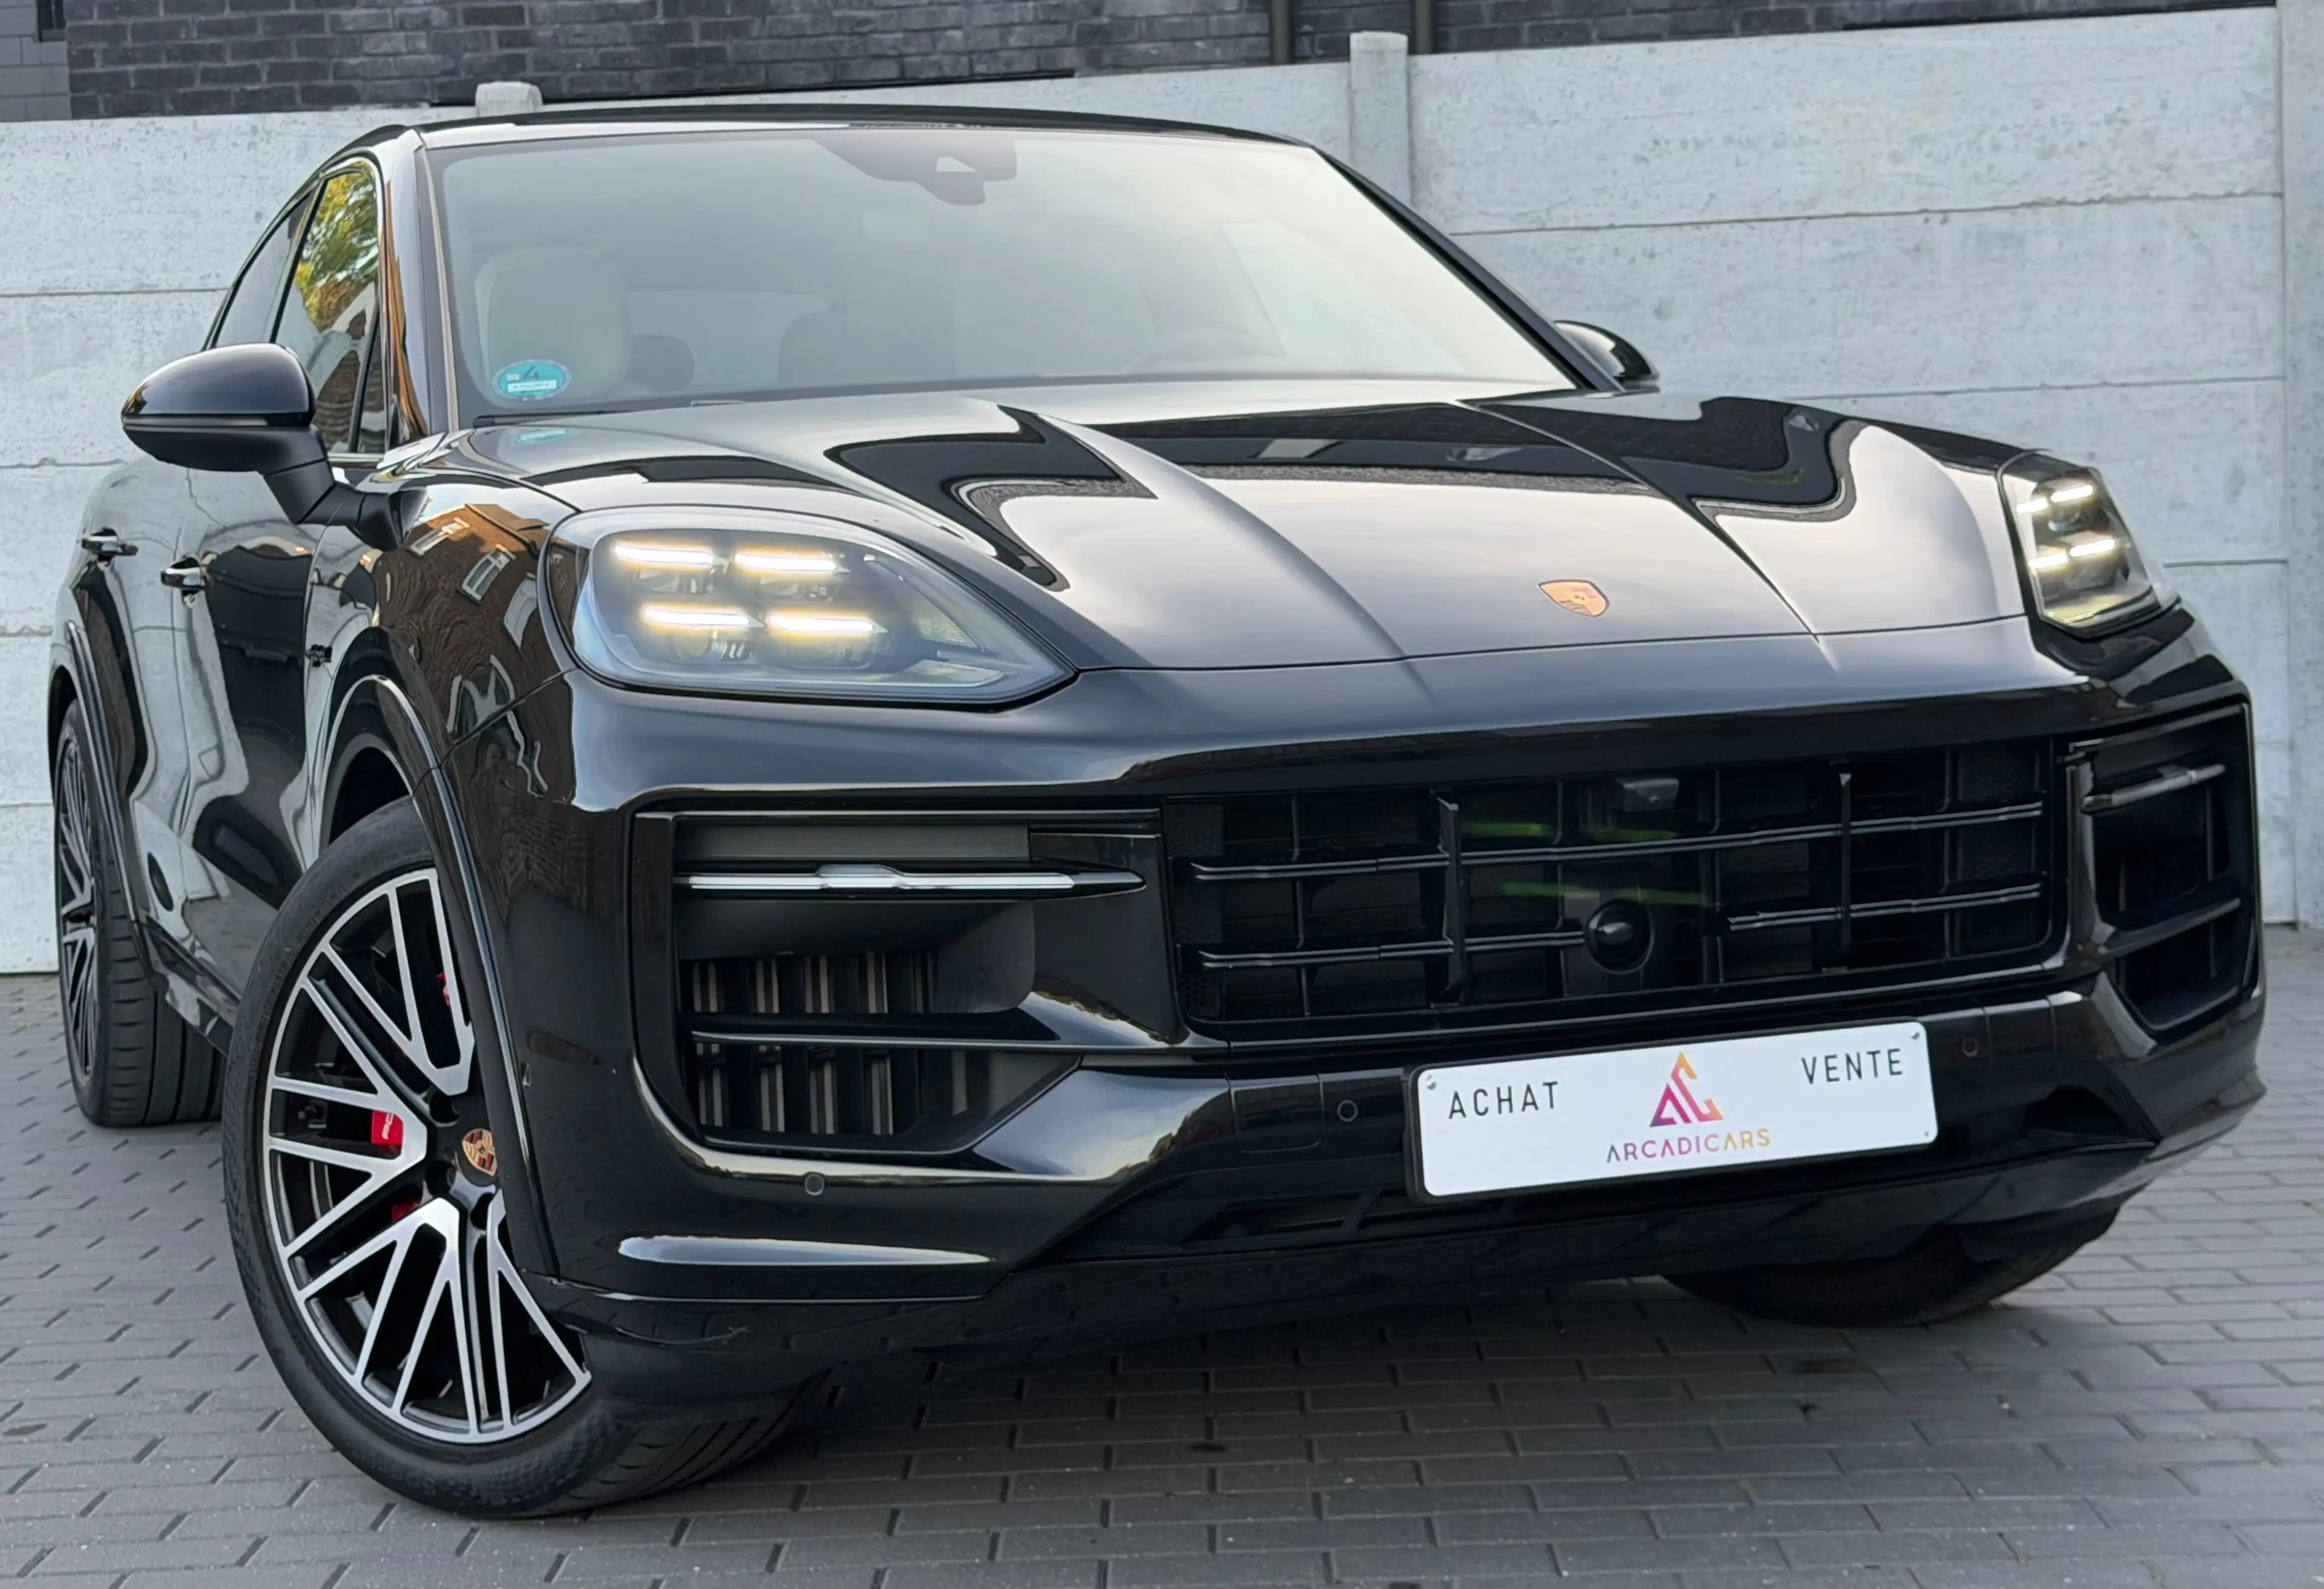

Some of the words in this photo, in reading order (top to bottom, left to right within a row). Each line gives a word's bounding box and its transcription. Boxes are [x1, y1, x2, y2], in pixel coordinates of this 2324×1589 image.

[1800, 1047, 1904, 1086] VENTE
[1447, 1080, 1560, 1121] ACHAT
[1605, 1128, 1772, 1164] ARCADICARS
